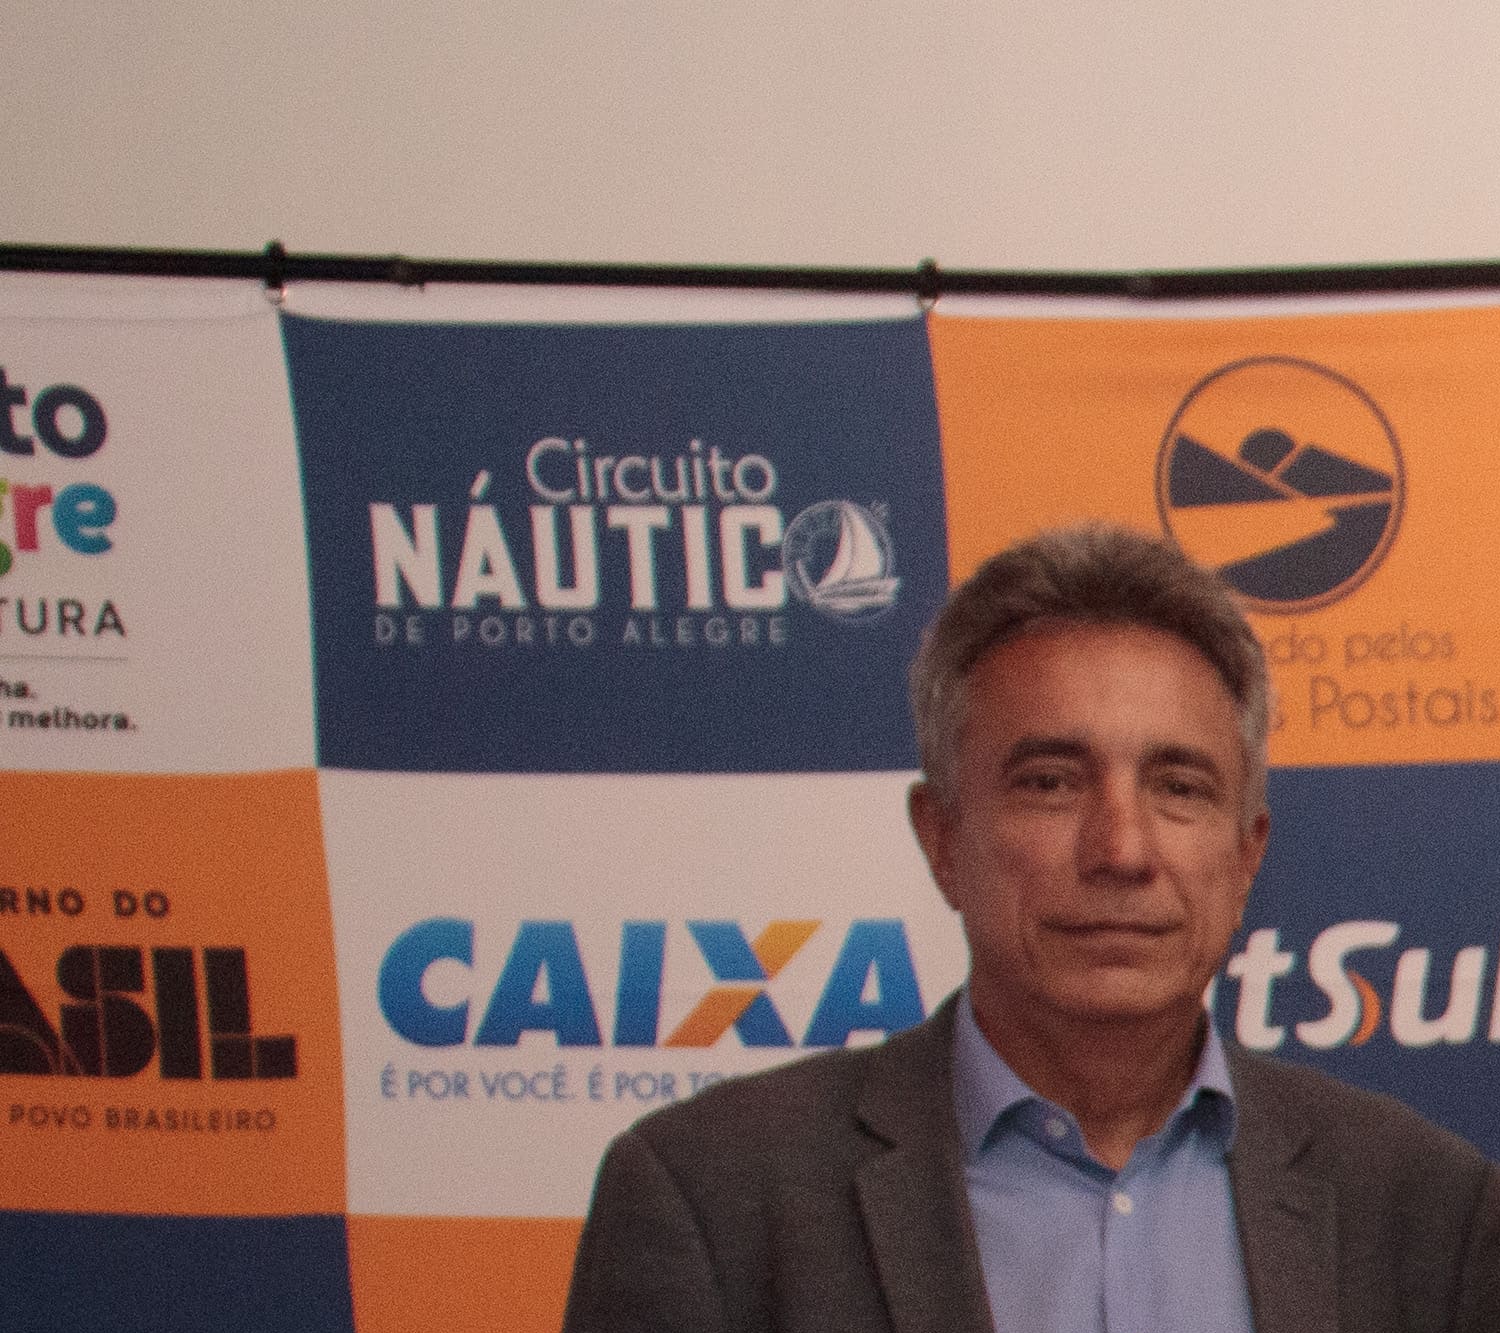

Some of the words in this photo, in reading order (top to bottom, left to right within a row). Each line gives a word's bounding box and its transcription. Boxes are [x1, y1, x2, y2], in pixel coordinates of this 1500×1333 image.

[525, 437, 778, 500] Circuito
[374, 615, 425, 645] DE
[453, 616, 594, 646] PORTO
[622, 617, 788, 646] ALEGRE
[1309, 674, 1499, 729] Postais
[112, 889, 170, 918] DO
[377, 917, 926, 1048] CAIXA
[381, 1062, 397, 1098] É
[408, 1070, 467, 1098] POR
[588, 1065, 602, 1100] É
[614, 1071, 676, 1101] POR
[8, 1103, 92, 1130] POVO
[105, 1106, 277, 1132] BRASILEIRO
